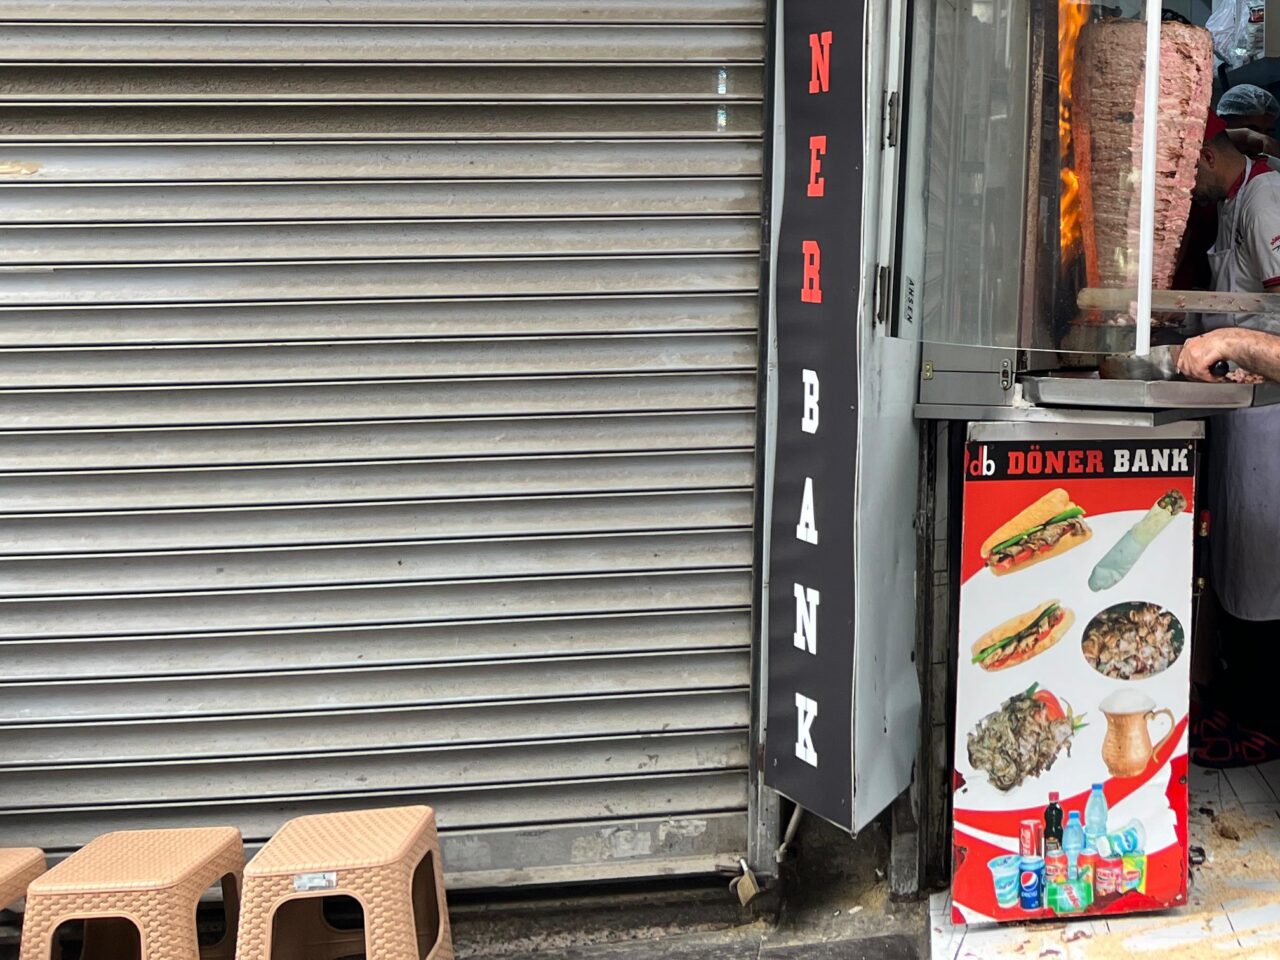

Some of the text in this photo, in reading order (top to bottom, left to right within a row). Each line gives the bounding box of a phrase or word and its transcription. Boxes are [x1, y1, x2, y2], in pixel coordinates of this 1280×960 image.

[969, 445, 1188, 476] db DÖNER BANK
[793, 369, 820, 769] BANK
